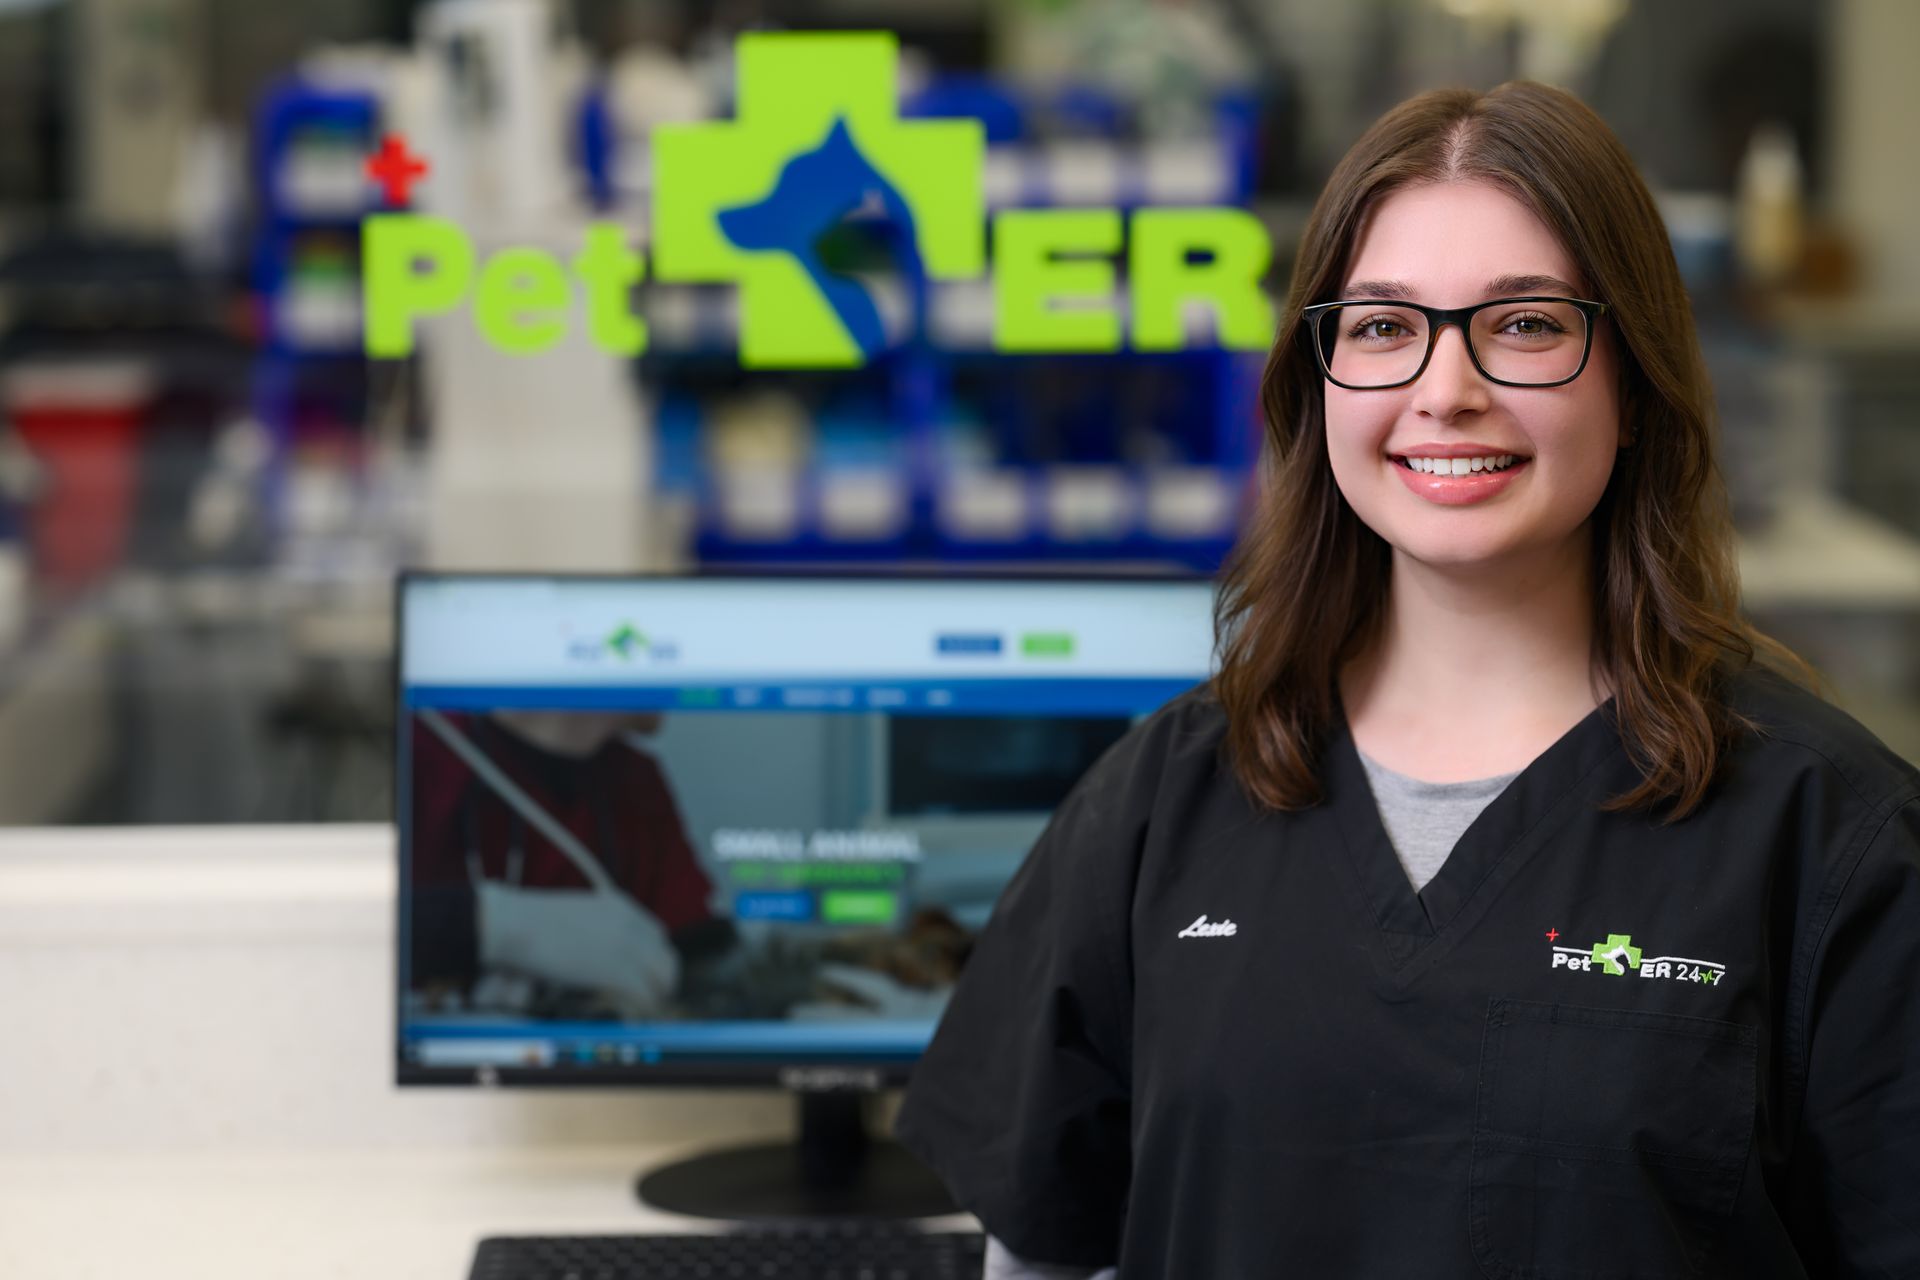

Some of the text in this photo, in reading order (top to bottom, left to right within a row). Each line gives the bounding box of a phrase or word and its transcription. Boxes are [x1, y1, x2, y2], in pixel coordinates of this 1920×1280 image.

[362, 208, 1275, 358] Pet ER
[1551, 952, 1592, 972] Pet
[1640, 961, 1672, 979] ER
